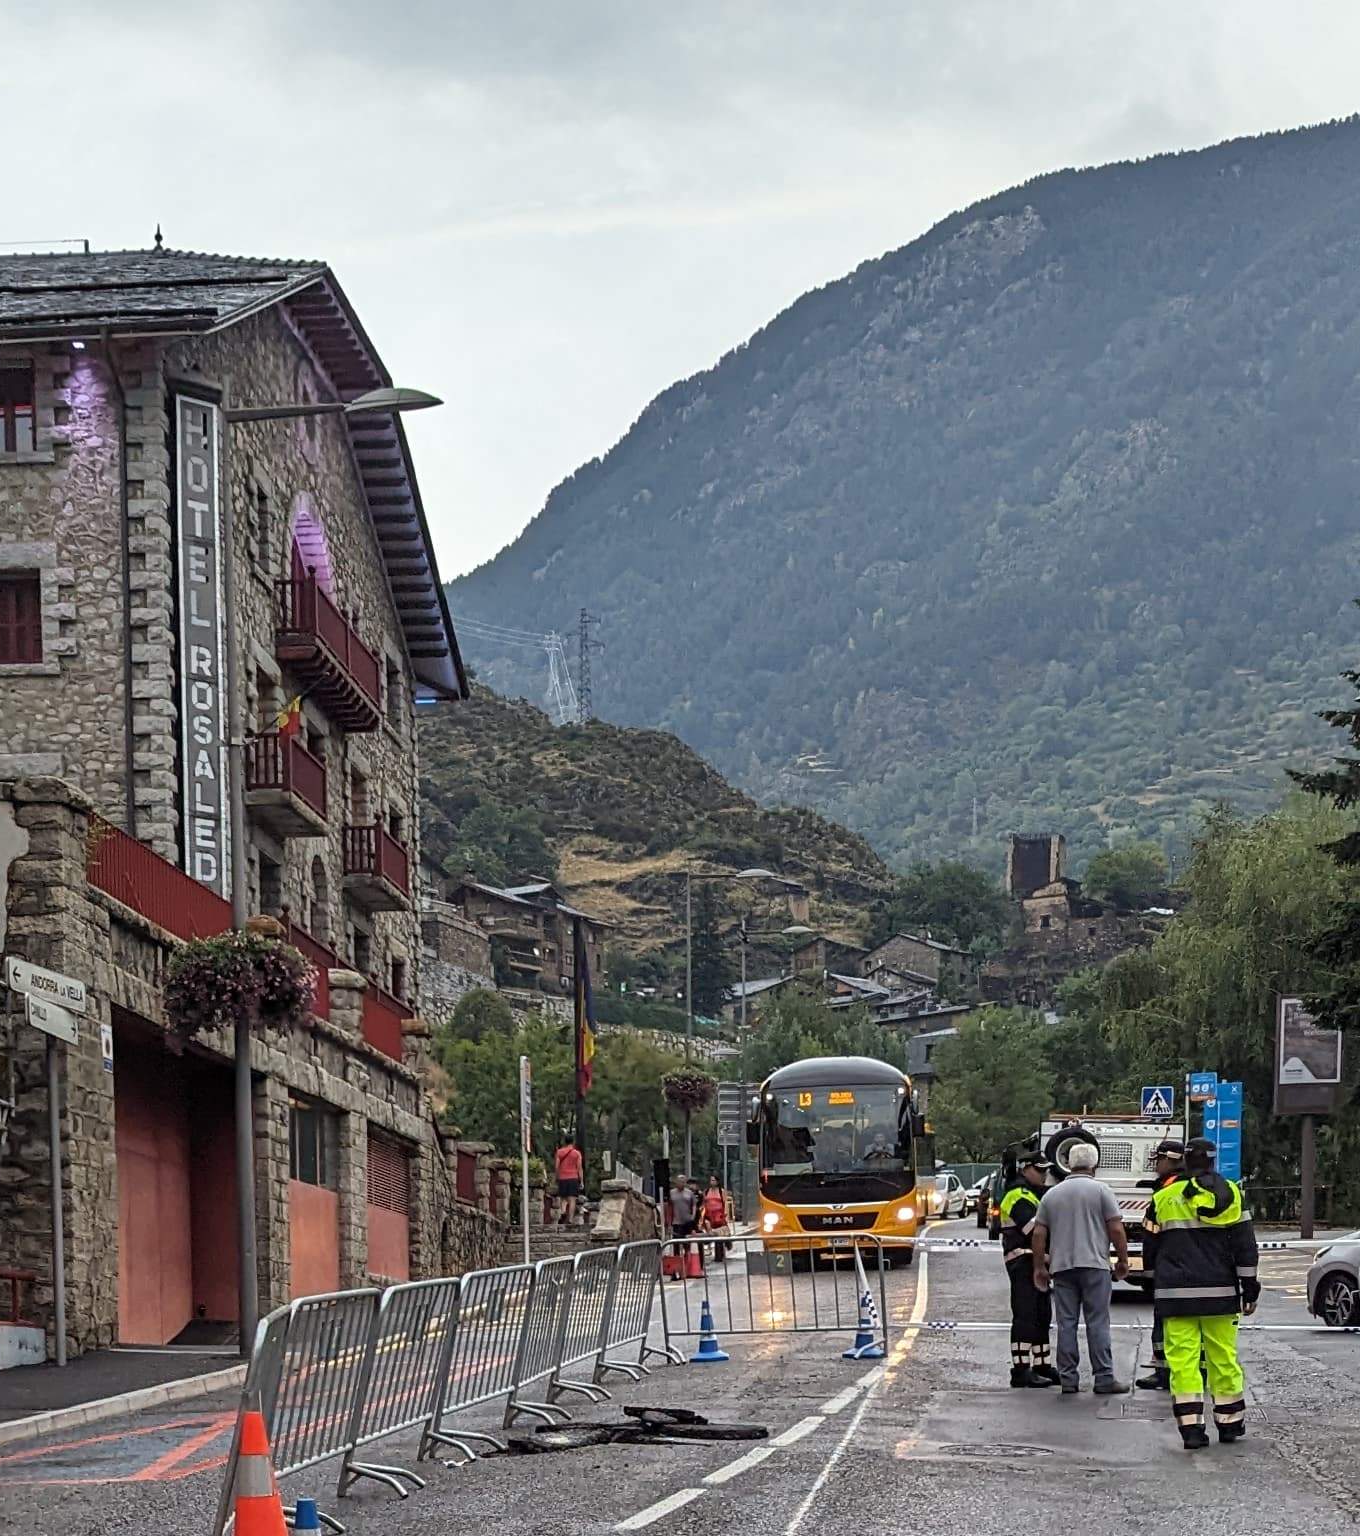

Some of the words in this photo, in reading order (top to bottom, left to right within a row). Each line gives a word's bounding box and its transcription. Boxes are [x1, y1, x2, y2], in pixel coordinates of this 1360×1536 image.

[184, 406, 212, 631] HOTEL
[799, 1092, 812, 1107] L3
[822, 1216, 854, 1225] MAN
